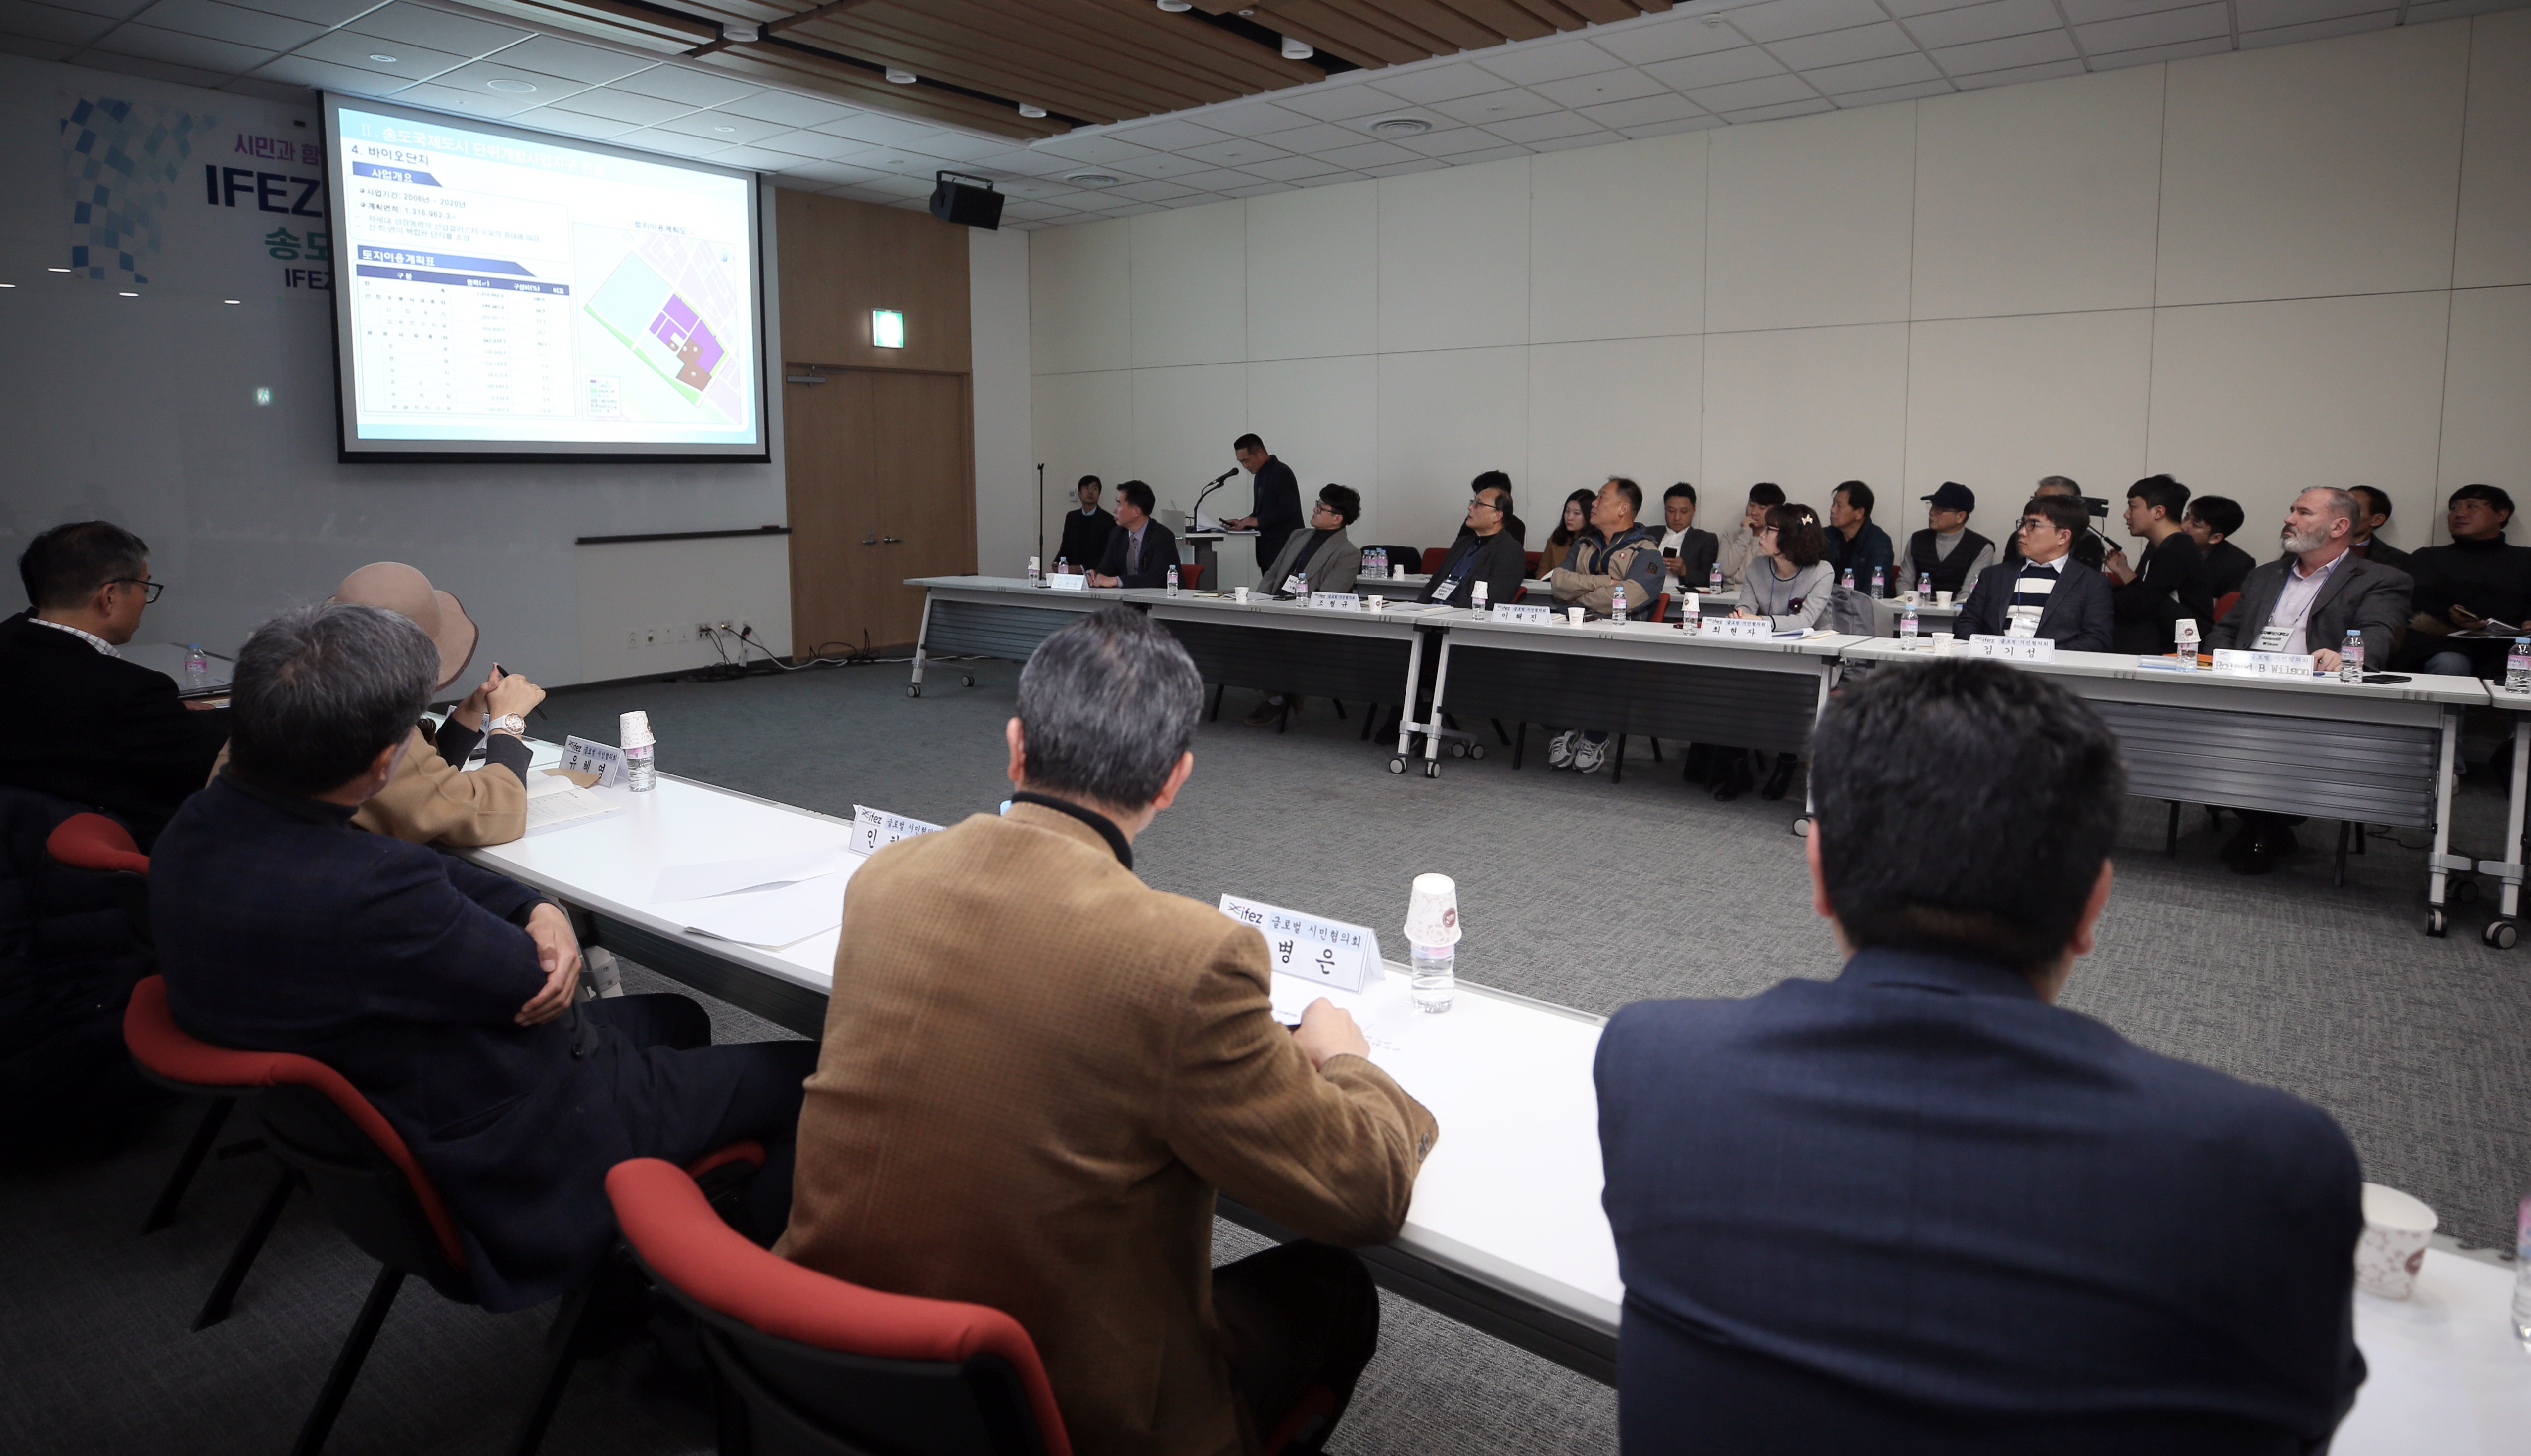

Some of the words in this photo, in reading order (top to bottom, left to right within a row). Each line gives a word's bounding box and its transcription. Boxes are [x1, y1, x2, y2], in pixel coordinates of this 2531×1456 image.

[234, 134, 296, 161] 시민과
[368, 146, 429, 166] 바이오단지
[382, 127, 469, 154] 송도국제도시
[473, 142, 577, 172] 단위개발사업지구
[582, 161, 606, 177] 현황
[372, 168, 413, 183] 사업개요
[205, 164, 323, 218] IFEZ
[403, 193, 429, 204] 2006년
[440, 198, 466, 209] 2020년
[368, 214, 391, 225] 차세대
[481, 228, 502, 238] 수요의
[362, 249, 435, 267] 토지이용계획표
[2258, 663, 2266, 673] B
[2271, 664, 2310, 676] Wilson
[887, 818, 905, 831] 글로벌
[867, 828, 877, 849] 인
[1240, 906, 1263, 924] ifez
[1271, 916, 1302, 934] 글로벌
[1308, 925, 1361, 949] 시민협의회
